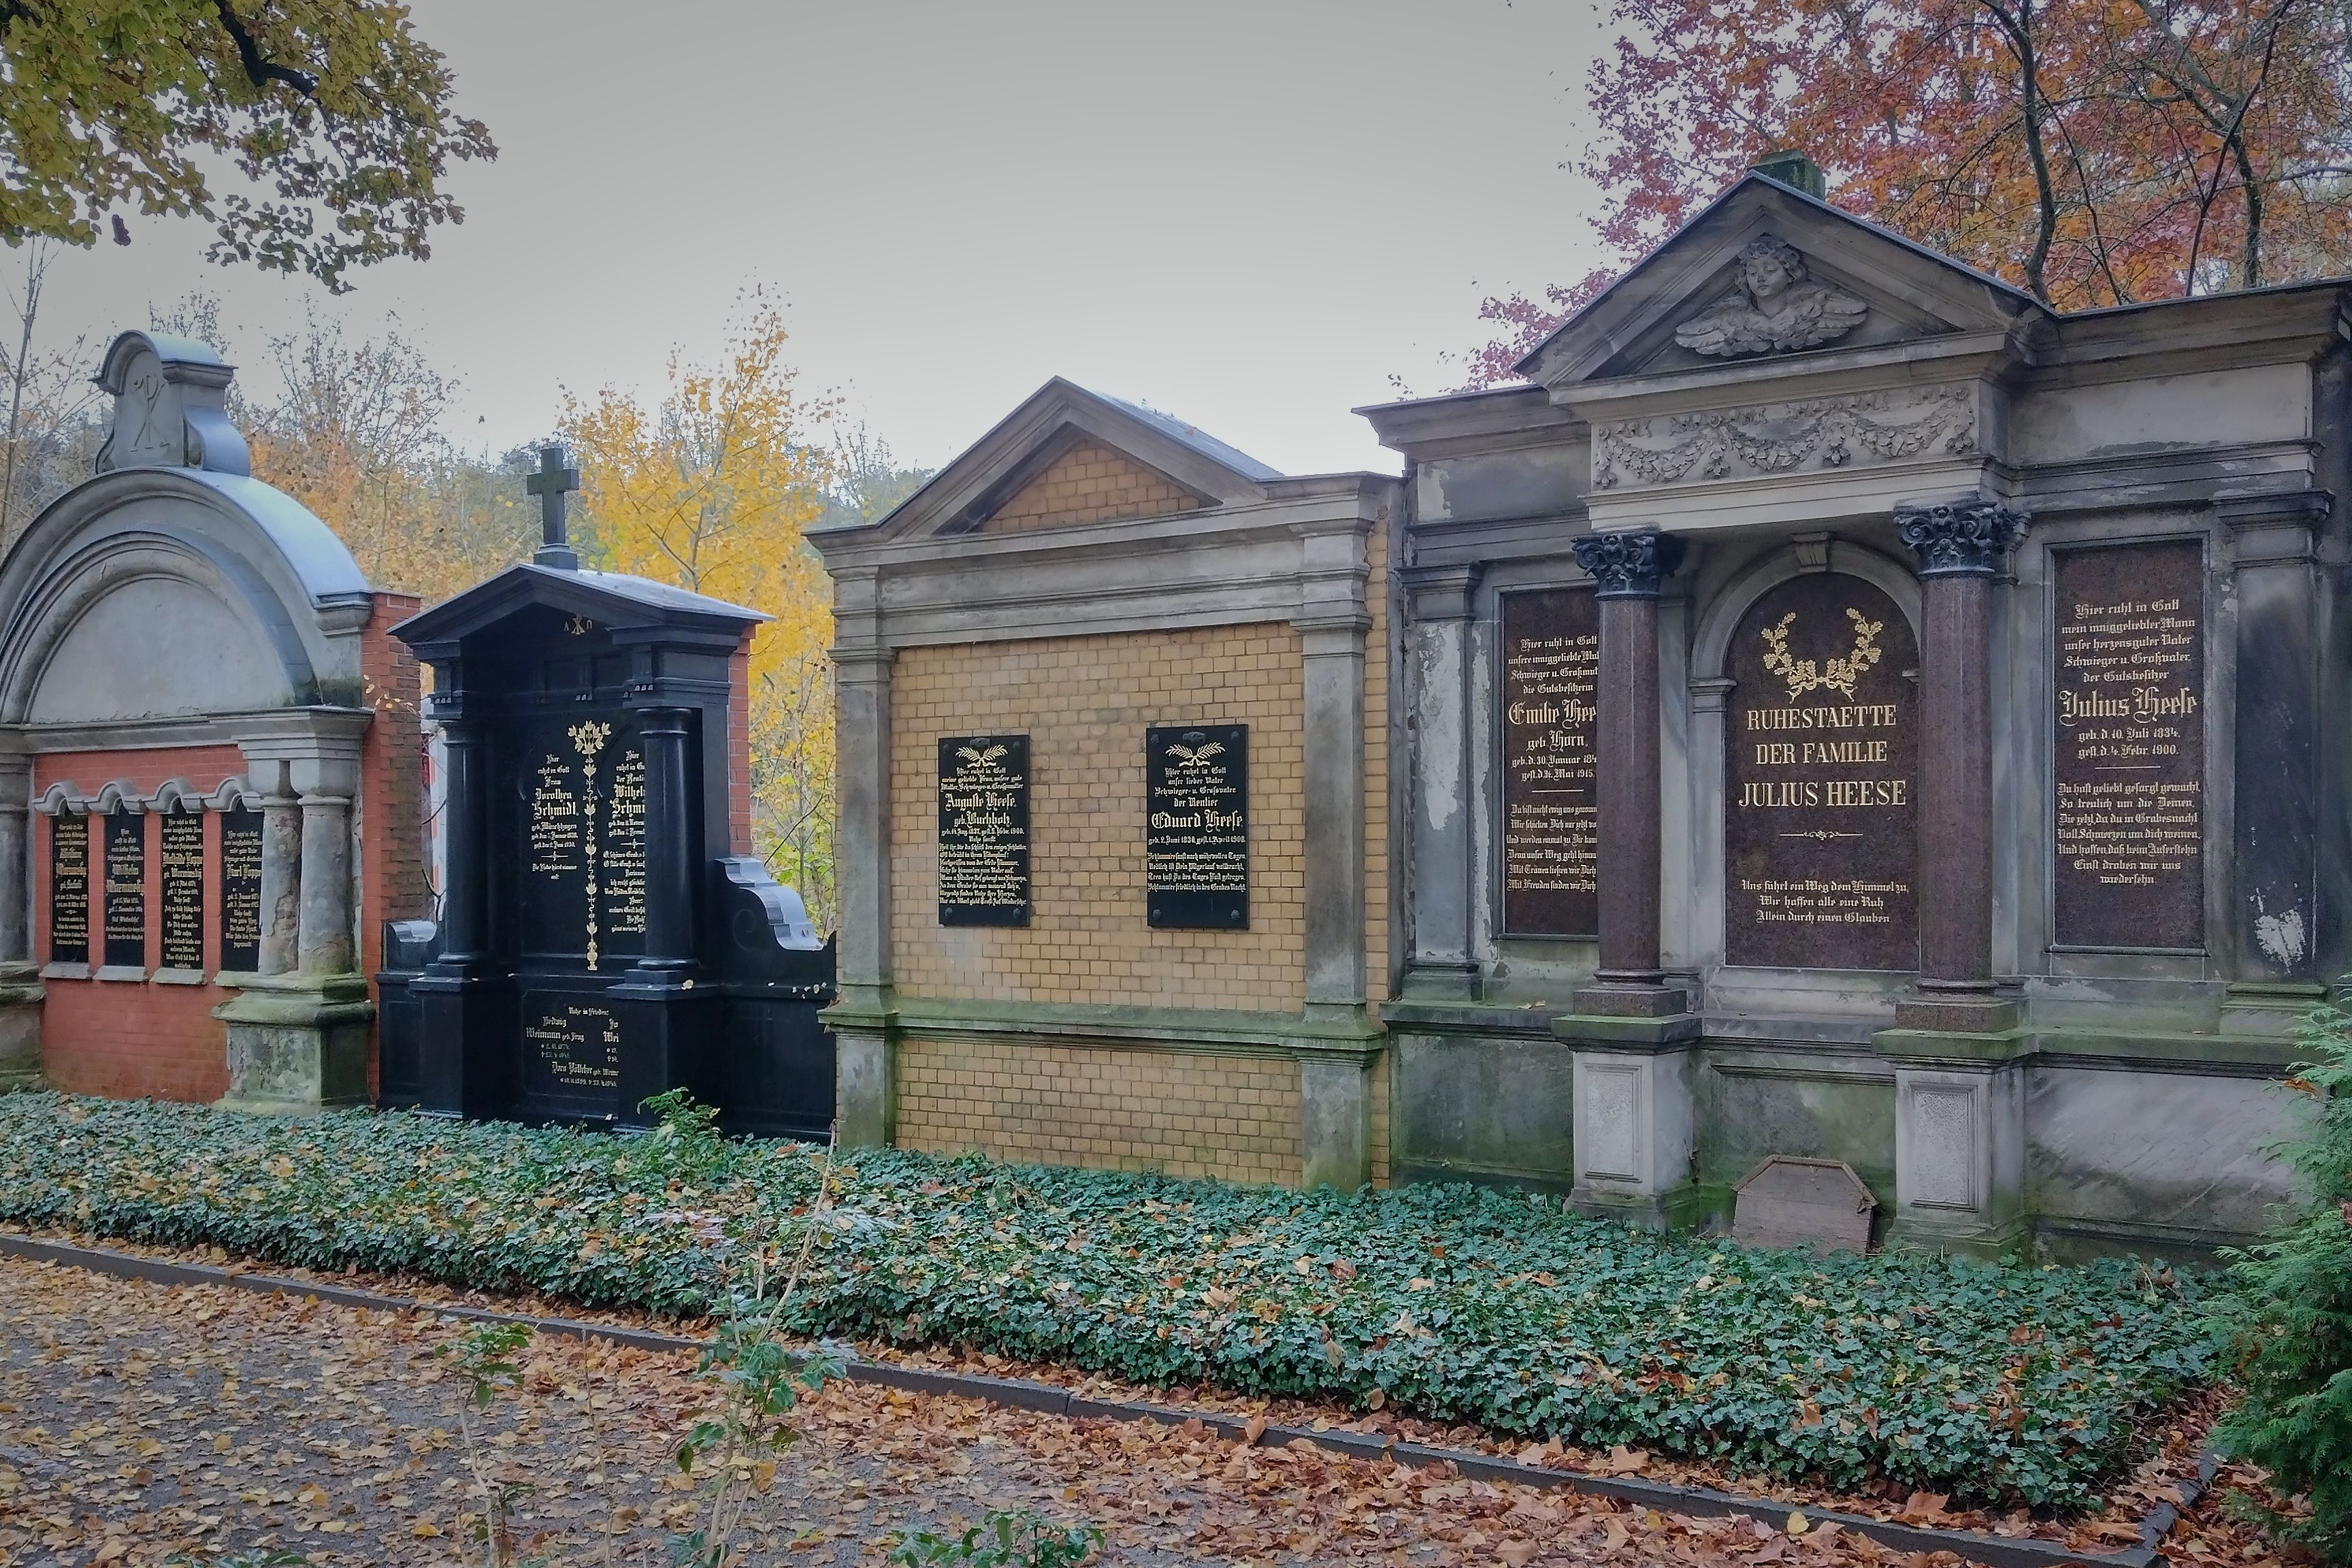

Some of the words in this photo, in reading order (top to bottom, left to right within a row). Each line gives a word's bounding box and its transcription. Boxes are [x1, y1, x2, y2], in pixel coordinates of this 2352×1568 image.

[2074, 603, 2105, 619] Hier
[2108, 602, 2132, 617] ruht
[2136, 602, 2148, 612] in
[2151, 599, 2180, 612] Gott
[2061, 624, 2087, 634] mein
[2159, 617, 2196, 632] Mann
[1520, 639, 1542, 652] Hier
[1544, 637, 1562, 650] ruht
[1565, 637, 1573, 647] in
[1577, 634, 1597, 645] Gott
[2064, 638, 2092, 651] unser
[2161, 634, 2192, 646] Vater
[1508, 654, 1531, 667] unsere
[2063, 655, 2119, 669] Schwieger
[1511, 669, 1550, 683] Schwieger
[2083, 672, 2101, 683] der
[1523, 684, 1535, 694] die
[1508, 700, 1561, 725] Emilie
[2059, 688, 2131, 726] Julius
[2132, 686, 2198, 723] Heese
[1747, 704, 1897, 730] RUHESTAETTE
[2126, 727, 2149, 741] Juli
[1549, 730, 1588, 753] Horn.
[1756, 744, 1797, 765] DER
[1803, 741, 1888, 764] FAMILIE
[2152, 744, 2179, 755] 1900.
[1511, 755, 1528, 768] geb.
[1164, 767, 1181, 778] Hier
[1211, 766, 1227, 774] Gott
[1553, 768, 1575, 781] Mai
[1186, 776, 1204, 784] lieber
[1738, 782, 1819, 807] JULIUS
[1826, 779, 1907, 806] HEESE
[2057, 783, 2072, 796] Du
[1173, 798, 1187, 807] der
[2059, 798, 2073, 809] So
[2117, 800, 2134, 808] um
[2137, 797, 2153, 808] die
[1152, 810, 1202, 829] Eduard
[2059, 813, 2076, 826] Die
[2110, 813, 2123, 823] du
[1506, 834, 1519, 844] Und
[2127, 830, 2144, 839] um
[2144, 828, 2163, 841] dich
[2057, 843, 2078, 855] Und
[2074, 859, 2100, 872] Einst
[2102, 859, 2138, 870] droben
[2139, 861, 2159, 870] wir
[2161, 861, 2183, 870] uns
[1742, 879, 1763, 892] Uns
[1789, 881, 1804, 892] ein
[1804, 879, 1829, 894] Weg
[1830, 879, 1851, 892] dem
[1759, 895, 1781, 906] Wir
[1818, 896, 1837, 907] alle
[1839, 896, 1860, 906] eine
[1756, 909, 1786, 924] Allein
[1788, 910, 1815, 926] durch
[1816, 912, 1842, 923] einen
[1844, 911, 1891, 924] Glauben
